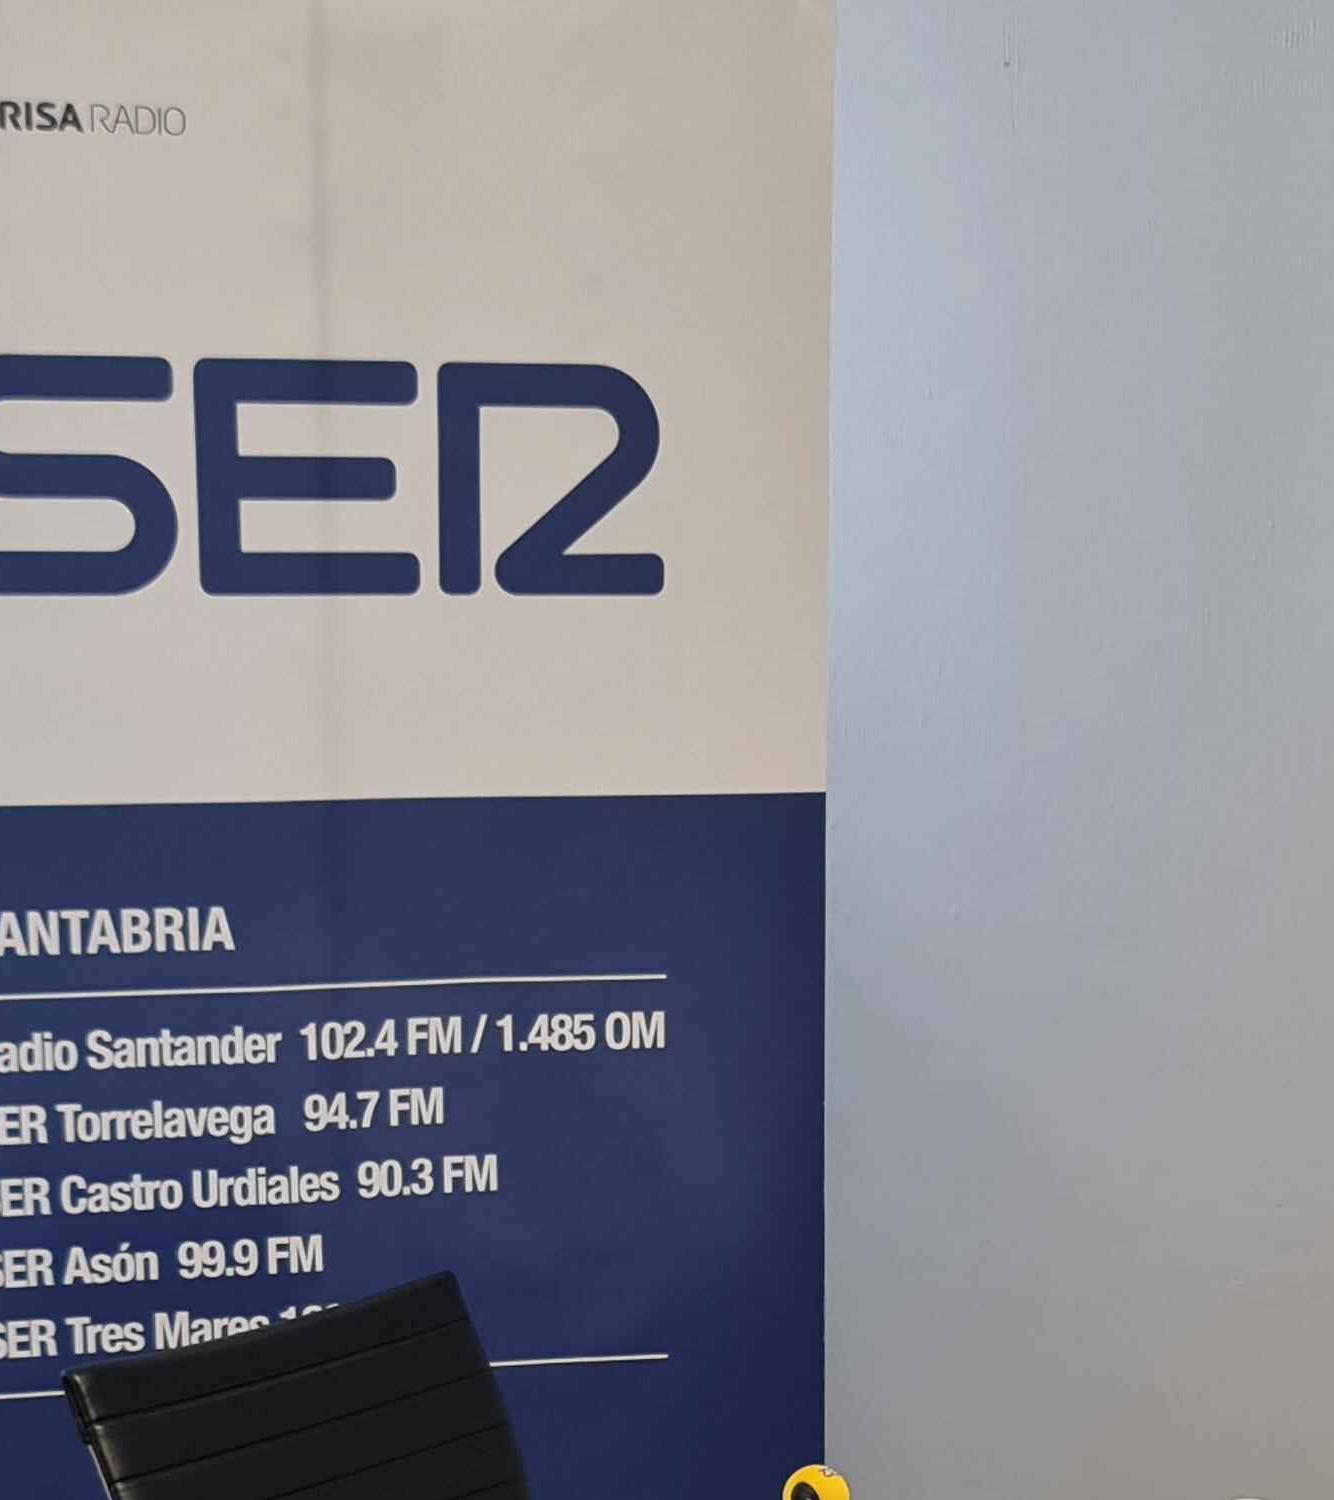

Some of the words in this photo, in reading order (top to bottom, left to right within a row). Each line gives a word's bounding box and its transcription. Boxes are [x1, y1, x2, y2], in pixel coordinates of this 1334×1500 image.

[89, 104, 187, 137] RADIO
[87, 1025, 281, 1070] Santander
[299, 1018, 397, 1061] 102.4
[406, 1015, 463, 1056] FM
[471, 1013, 488, 1053] /
[496, 1012, 596, 1053] 1.485
[57, 1099, 276, 1145] Torrelavega
[303, 1090, 381, 1132] 94.7
[389, 1086, 445, 1126] FM
[61, 1170, 182, 1214] Castro
[192, 1165, 340, 1208] Urdiales
[357, 1158, 432, 1200] 90.3
[442, 1154, 499, 1194] FM
[65, 1241, 159, 1284] Asón
[177, 1238, 259, 1278] 99.9
[268, 1234, 324, 1273] FM
[66, 1311, 144, 1354] Tres
